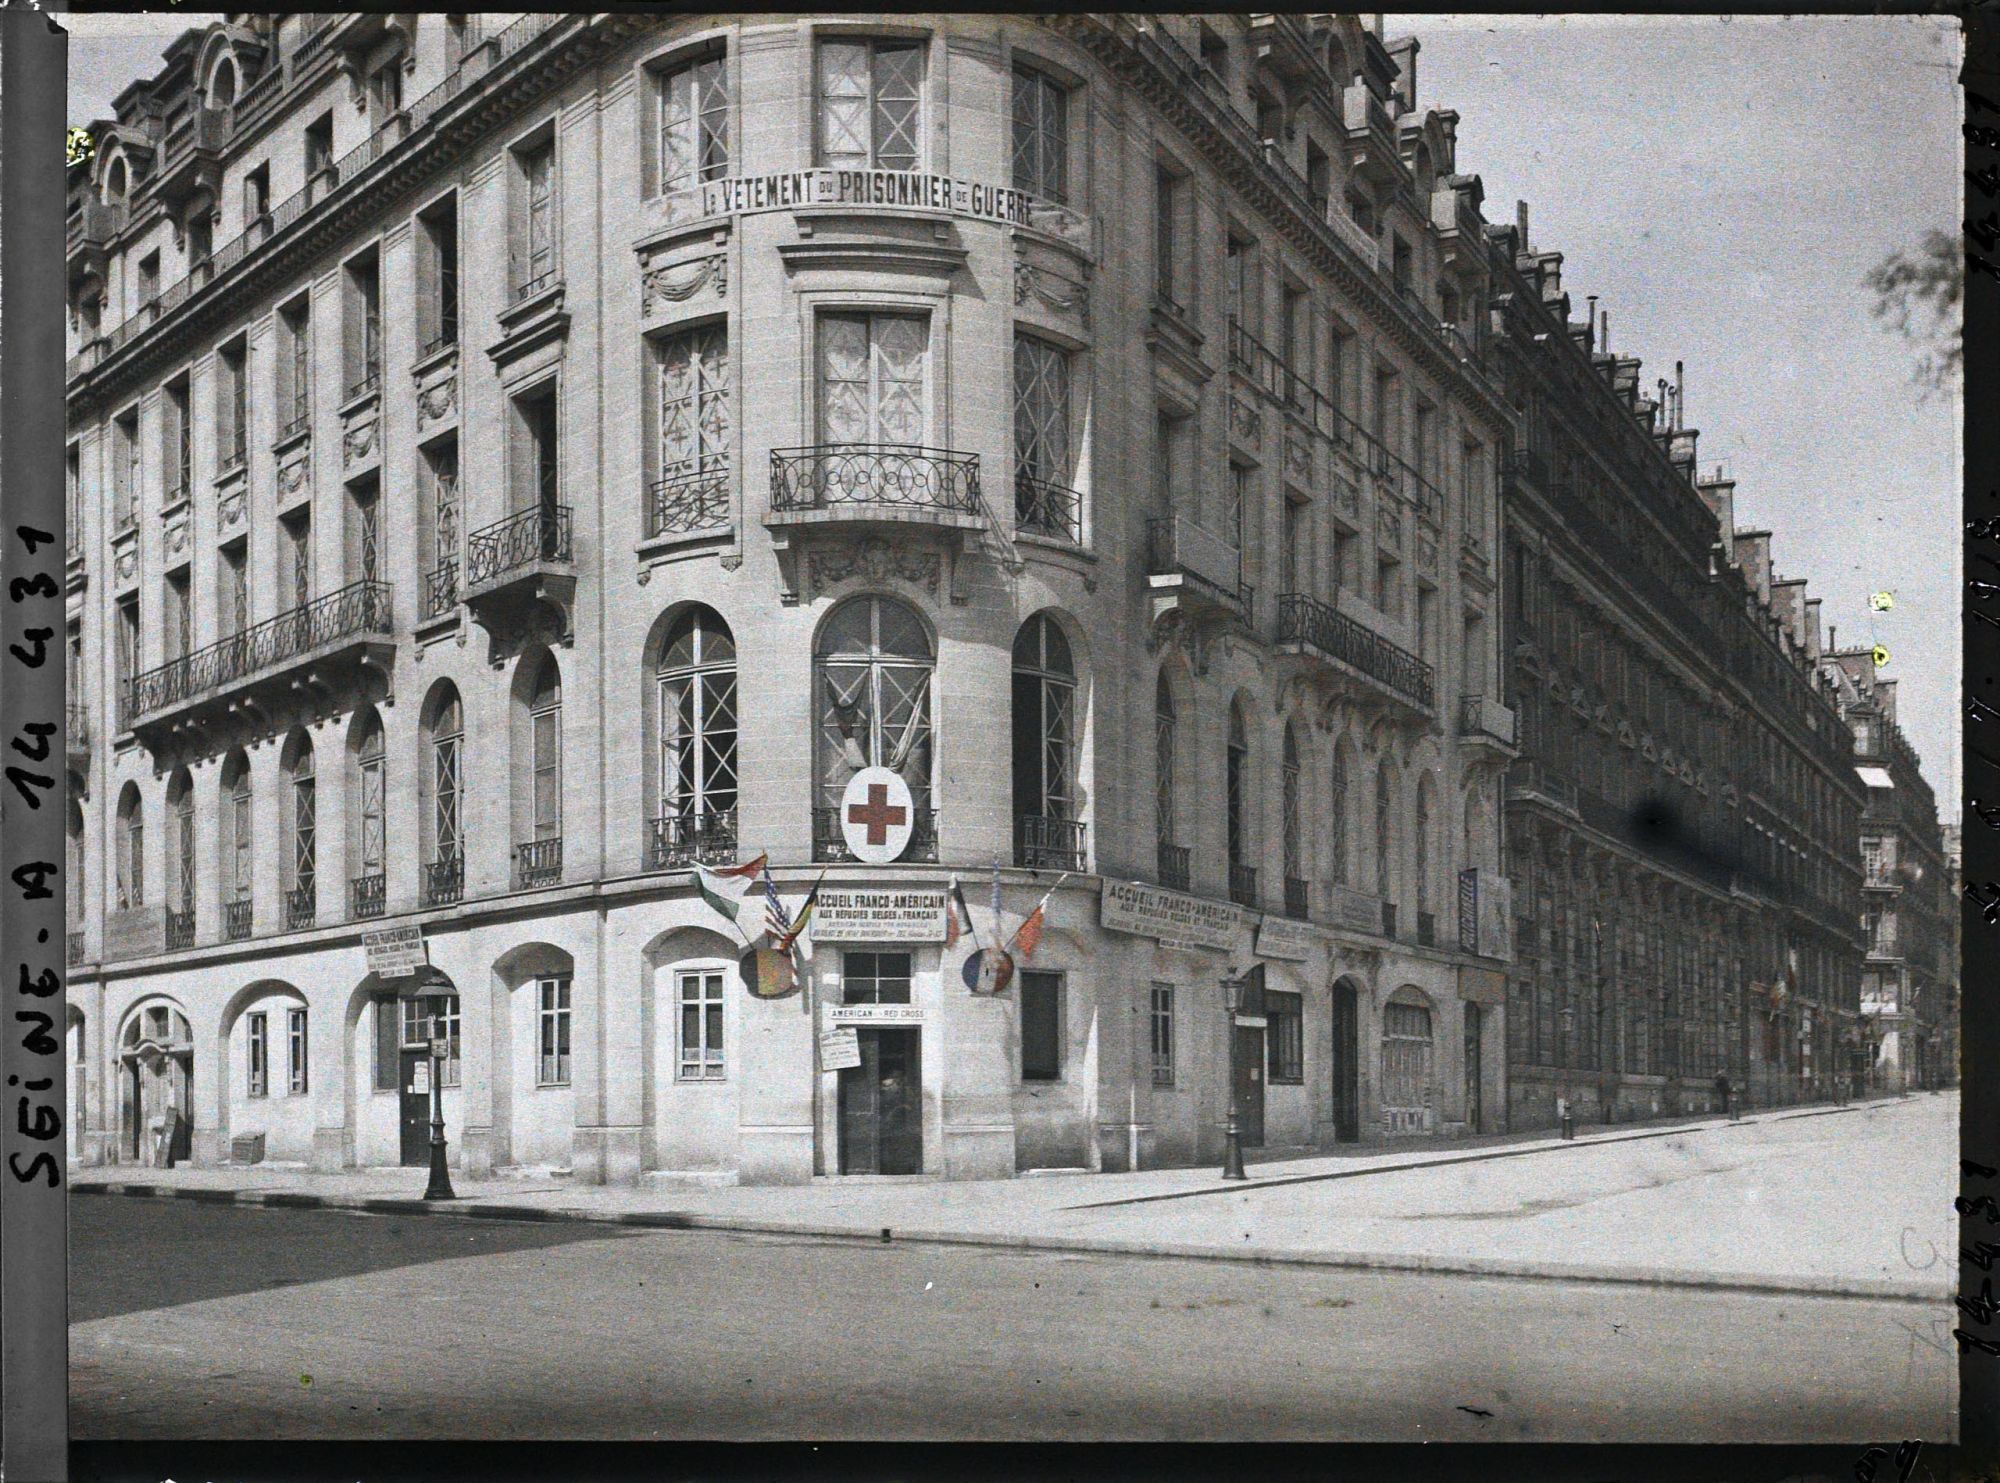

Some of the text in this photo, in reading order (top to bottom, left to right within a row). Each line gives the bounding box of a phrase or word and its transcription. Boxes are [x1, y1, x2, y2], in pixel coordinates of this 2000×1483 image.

[721, 171, 813, 212] VETEMENT
[819, 181, 832, 193] DU
[839, 171, 950, 208] PRISONNIER
[956, 190, 967, 203] DE
[971, 183, 1033, 228] GUERRE
[814, 894, 852, 908] ACCUEIL
[1109, 885, 1153, 908] ACCUEIL
[819, 910, 832, 919] AUX
[832, 1009, 925, 1018] AMERICAN RED CROSS
